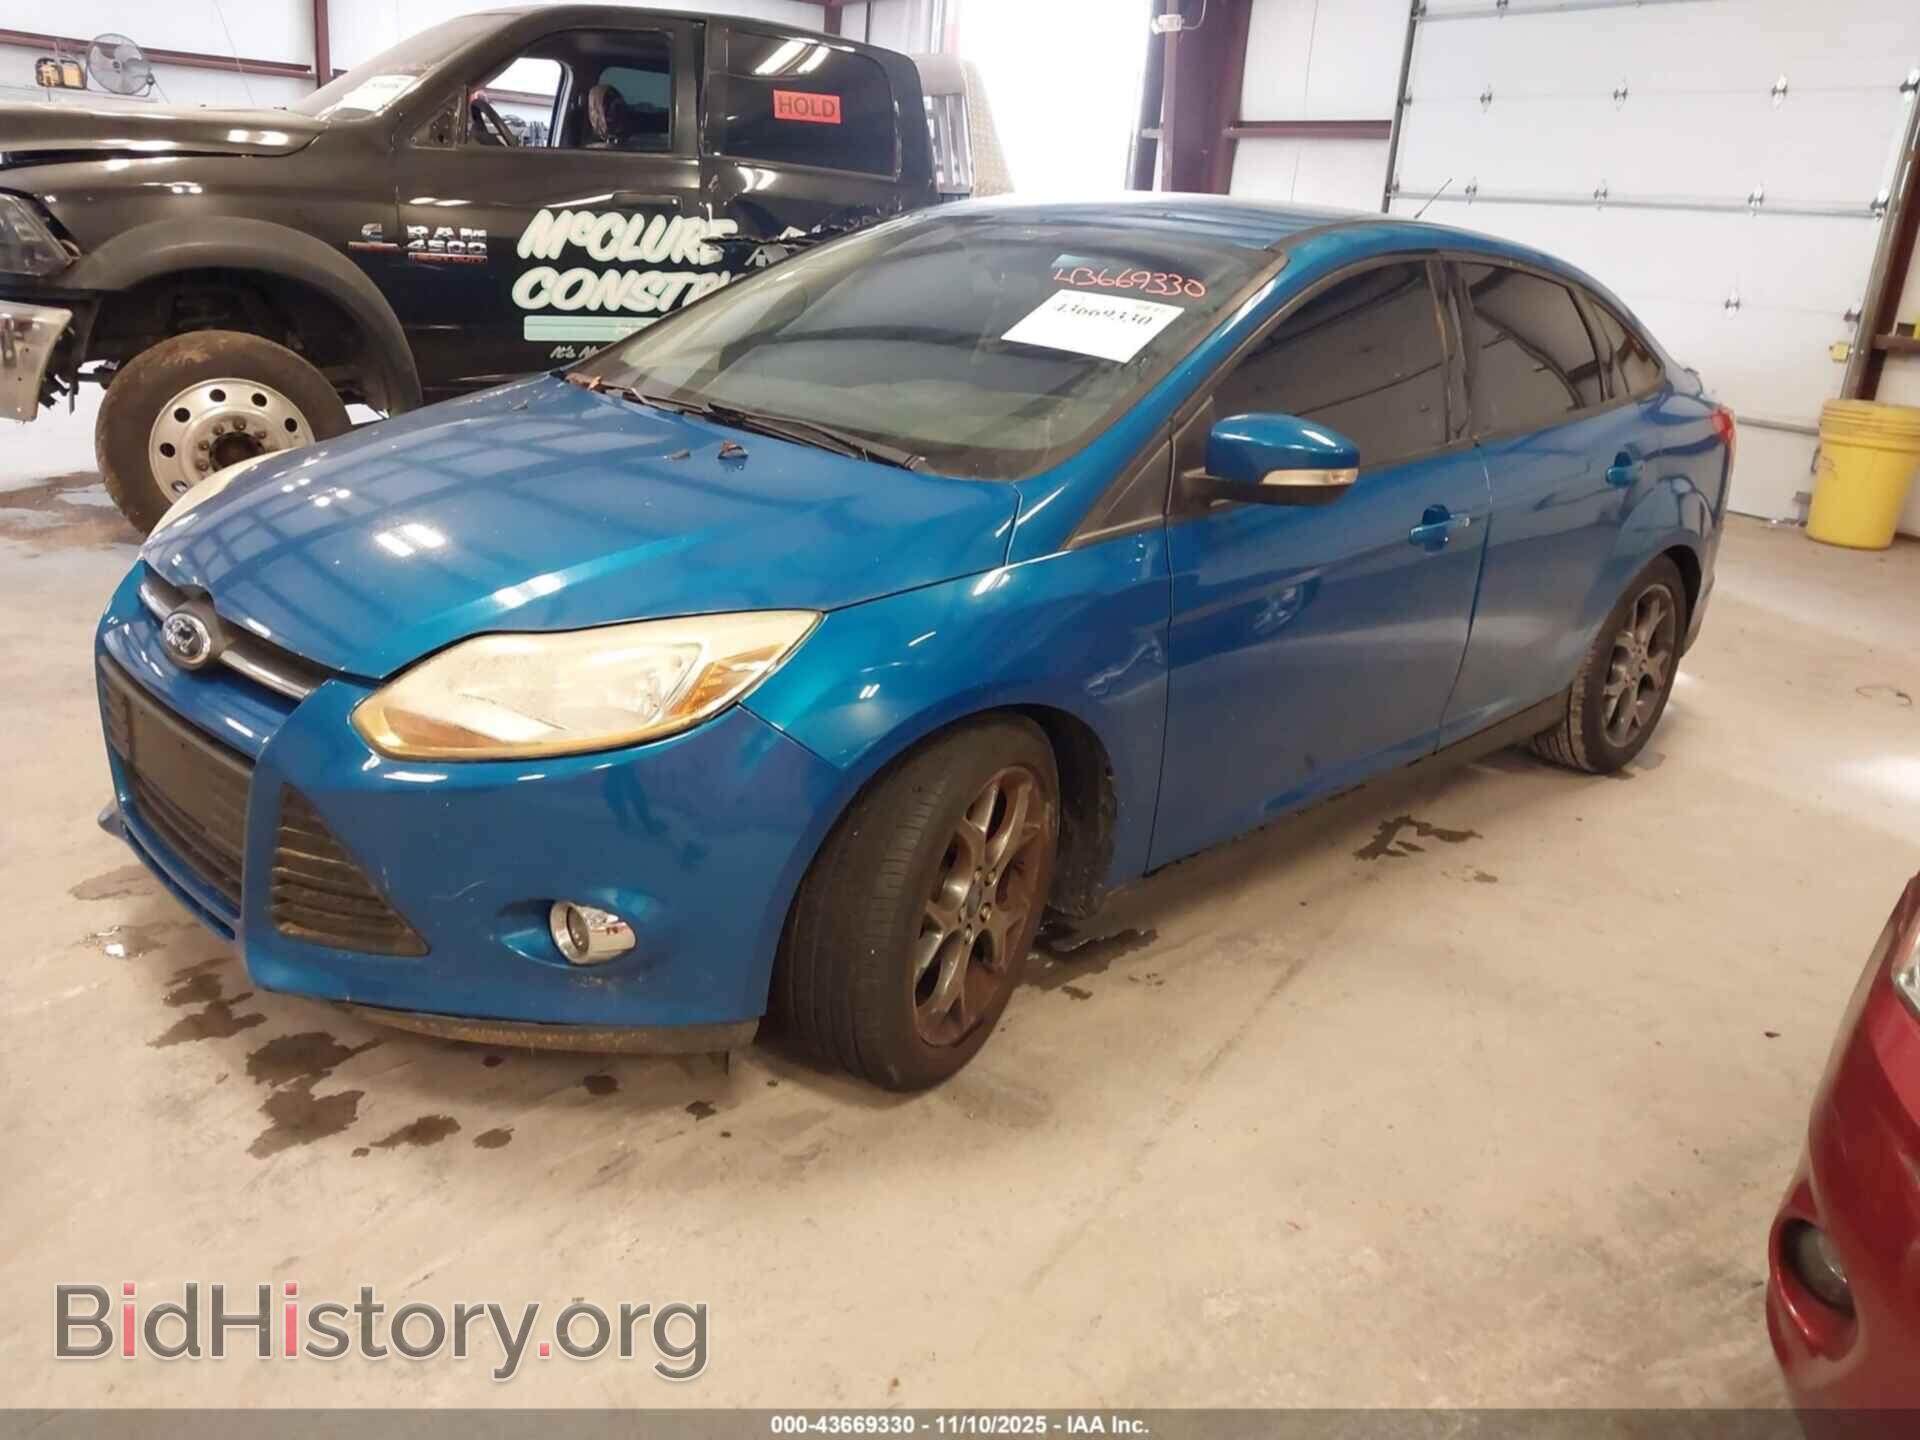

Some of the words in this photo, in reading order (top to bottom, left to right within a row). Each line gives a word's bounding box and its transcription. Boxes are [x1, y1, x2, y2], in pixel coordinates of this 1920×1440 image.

[778, 95, 836, 118] HOLD
[406, 225, 487, 240] RAM
[406, 239, 487, 255] 4500
